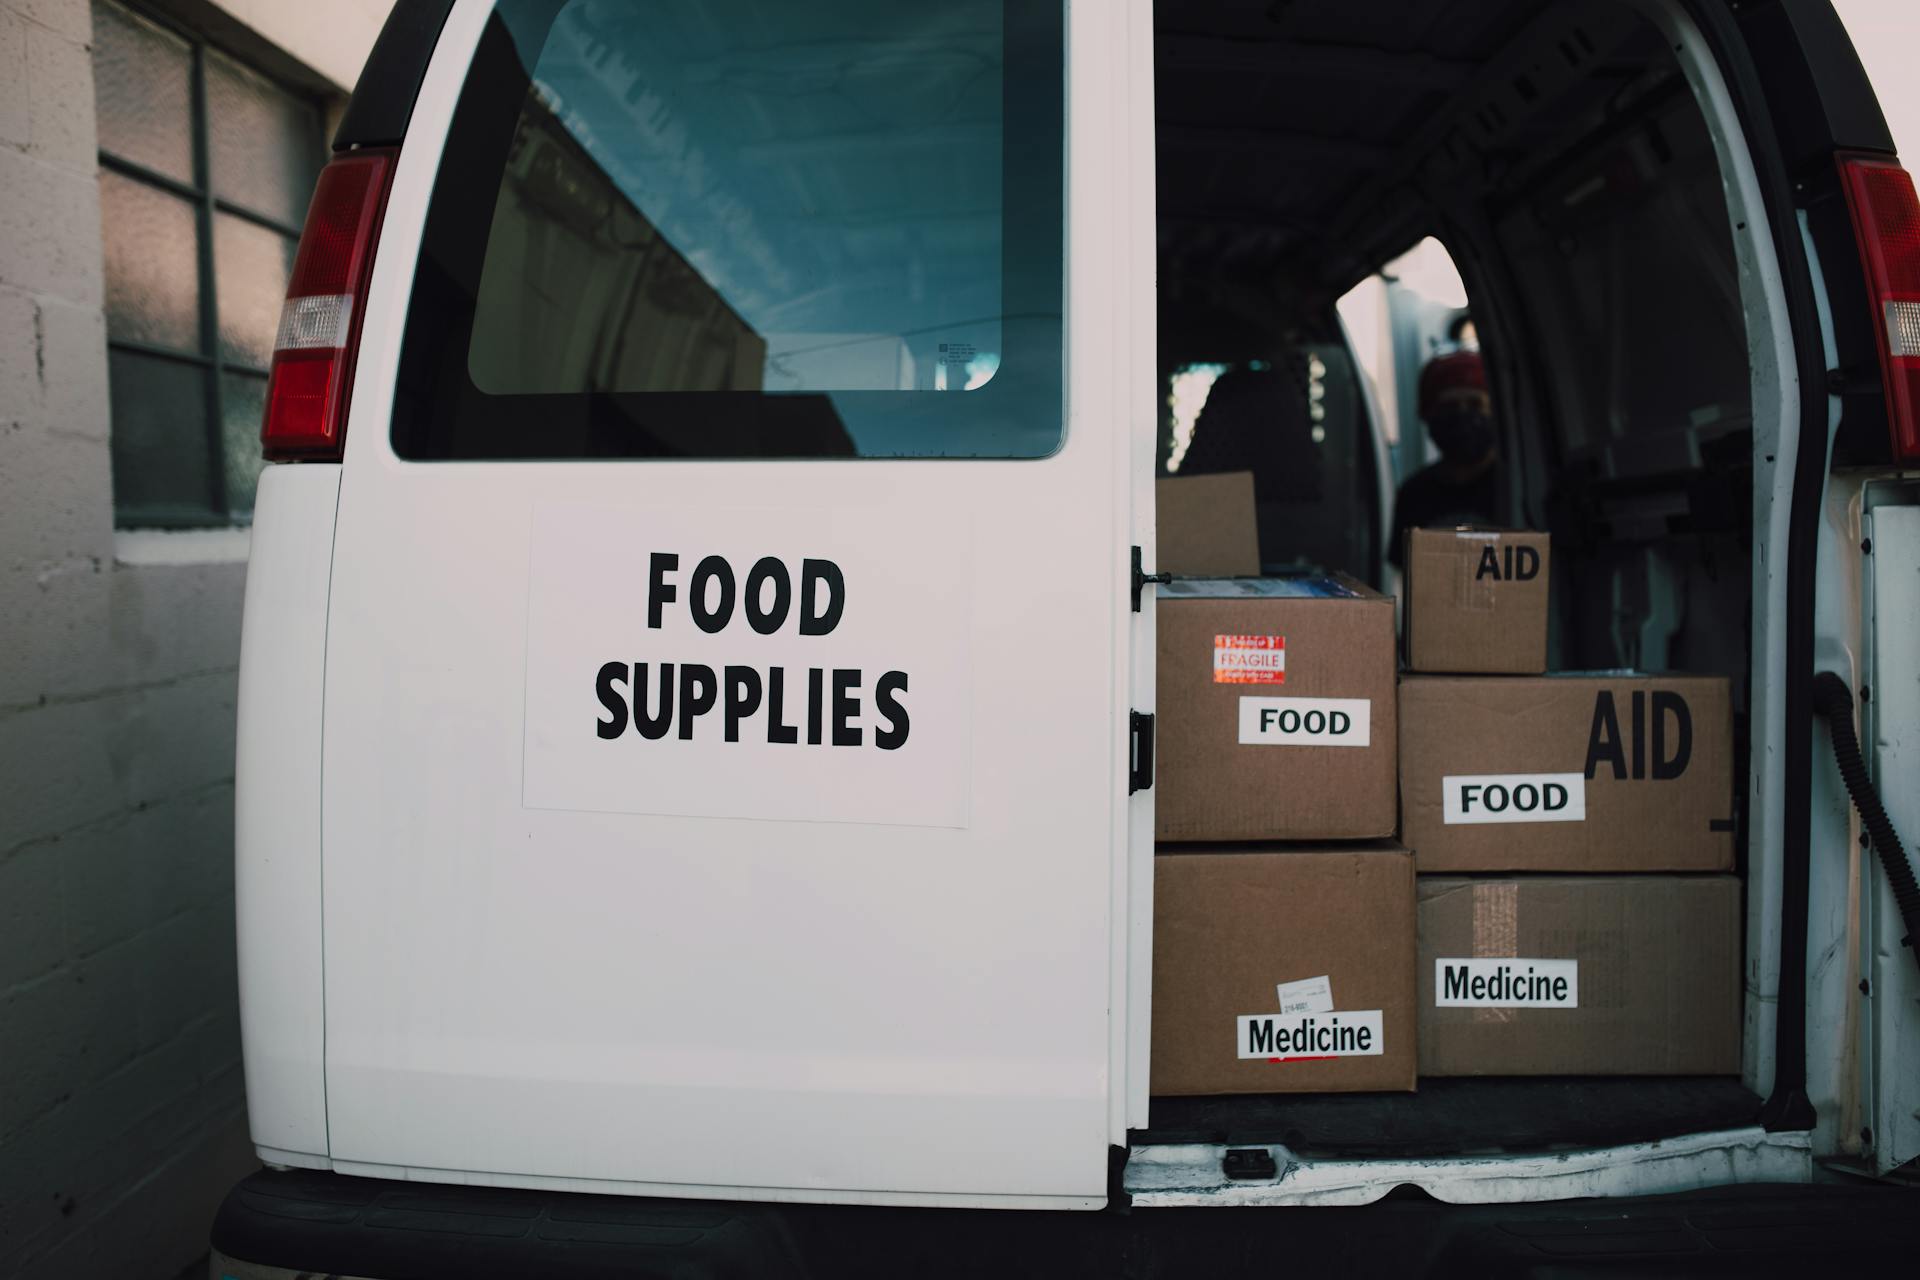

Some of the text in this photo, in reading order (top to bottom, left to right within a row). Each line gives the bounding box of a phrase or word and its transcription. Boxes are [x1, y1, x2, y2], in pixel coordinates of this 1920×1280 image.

[1475, 545, 1541, 581] AID
[647, 552, 846, 636] FOOD
[1220, 653, 1279, 667] FRAGILE
[595, 661, 911, 751] SUPPLIES
[1259, 708, 1352, 736] FOOD
[1583, 690, 1693, 781] AID
[1460, 783, 1570, 813] FOOD
[1444, 965, 1568, 1001] Medicine
[1248, 1017, 1372, 1053] Medicine
